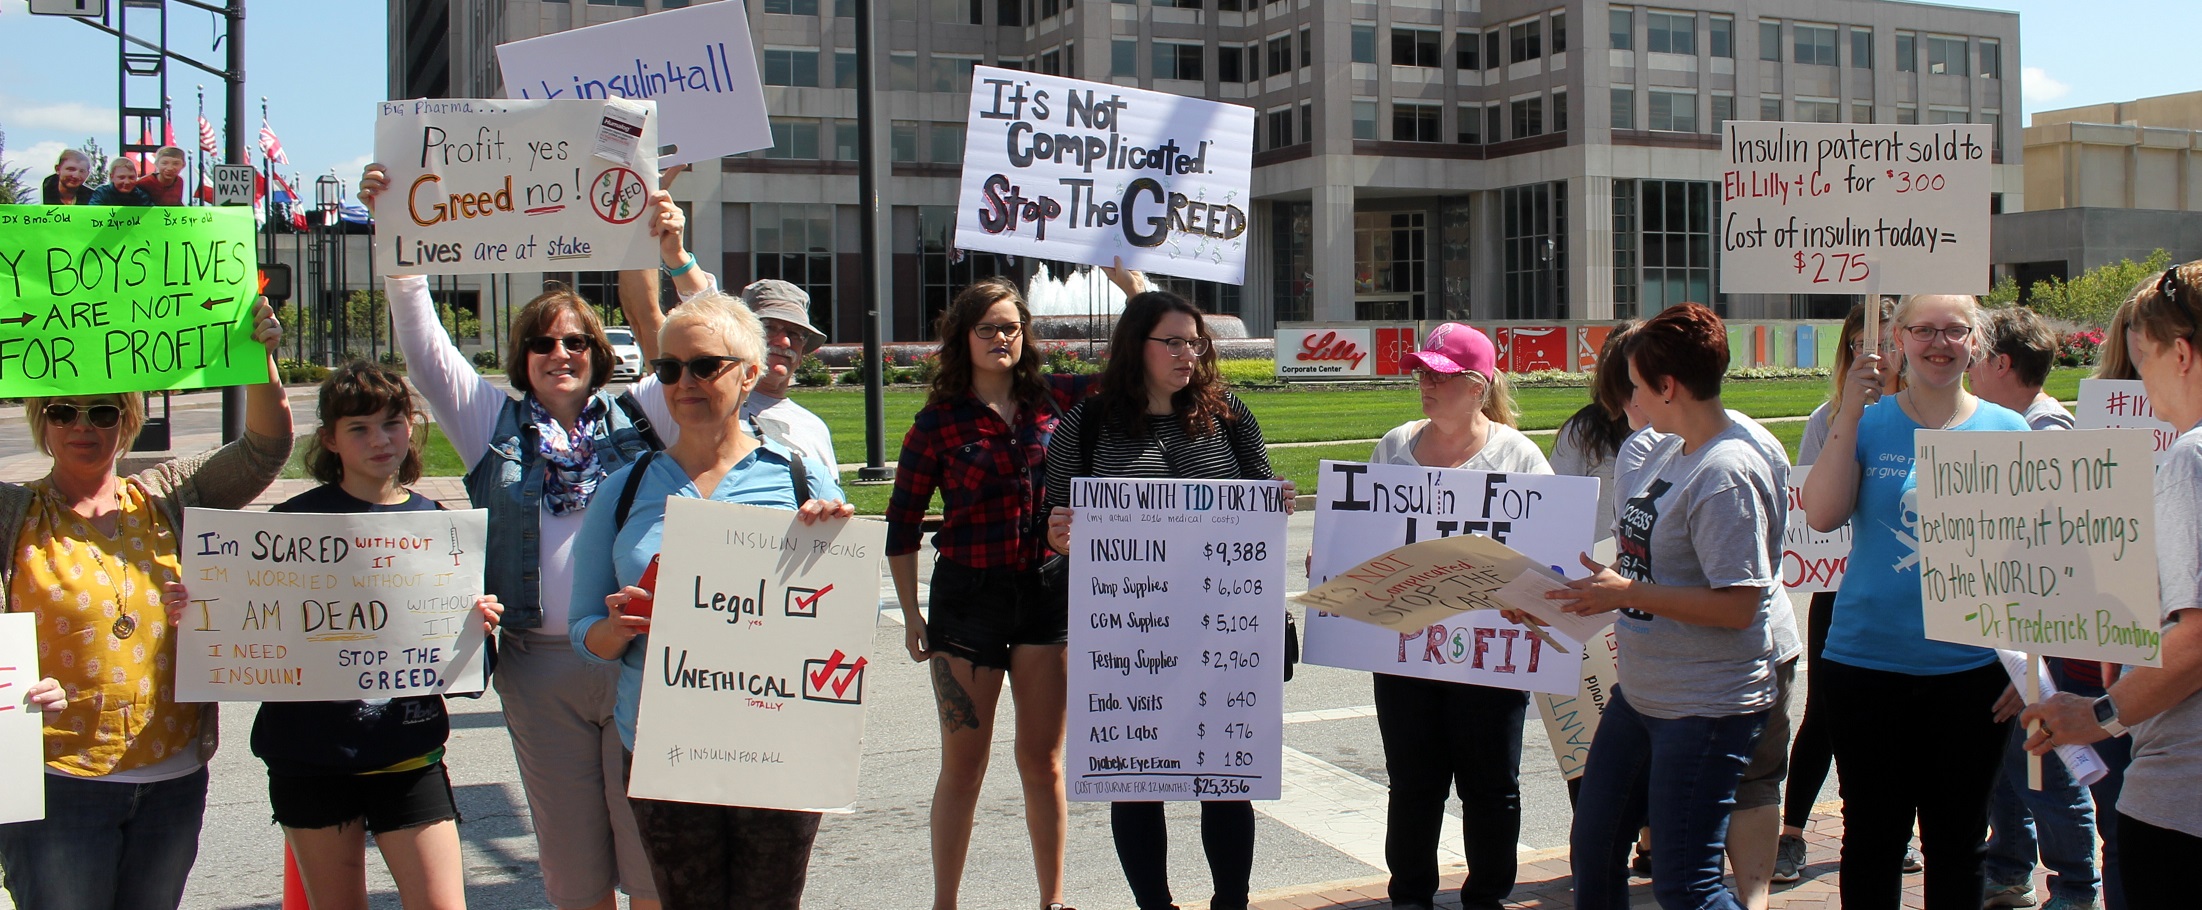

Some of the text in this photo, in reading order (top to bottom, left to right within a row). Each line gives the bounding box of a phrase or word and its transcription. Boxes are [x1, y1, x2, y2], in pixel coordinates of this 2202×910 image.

[980, 78, 1127, 132] It's Not
[421, 126, 568, 171] Profit, yes
[1731, 126, 1983, 172] Insulin patent sold to
[218, 184, 250, 196] WAY
[219, 169, 249, 182] ONE
[1725, 164, 1945, 205] Eli Lilly Co for $3.00
[408, 174, 515, 226] Greed
[979, 174, 1247, 247] Stop The GREED
[127, 216, 140, 225] old
[202, 213, 212, 223] old
[1725, 212, 1767, 251] Cost
[1775, 216, 1798, 248] of
[1804, 217, 1870, 248] insulin
[165, 240, 245, 286] LIVES
[396, 235, 591, 266] Lives are at stake
[1794, 251, 1869, 283] $275
[43, 293, 193, 331] ARE NOT
[0, 320, 237, 379] FOR PROFIT
[1296, 332, 1366, 370] Lilly
[1282, 366, 1317, 374] Corporate
[2009, 441, 2061, 496] does
[2073, 449, 2117, 493] not
[1073, 481, 1287, 513] LIVING WITH T1D FOR 1 YEA
[1331, 464, 1542, 520] Insulin For
[1109, 514, 1131, 522] actual
[1141, 514, 1161, 522] 2016
[1168, 514, 1202, 523] medical
[1212, 514, 1239, 525] costs)
[1625, 525, 1632, 538] TO
[1921, 513, 1975, 557] belong
[1978, 510, 1995, 540] to
[2033, 509, 2051, 546] it
[2059, 507, 2139, 561] belongs
[197, 530, 433, 564] I'm SCARED WITHOUT
[726, 529, 865, 558] INSULIN PRICING
[1091, 539, 1165, 562] INSULIN
[372, 556, 395, 569] IT
[1346, 554, 1414, 585] NOT
[247, 571, 337, 590] WORRIED
[353, 573, 424, 588] WITHOUT
[433, 573, 454, 587] IT
[1092, 577, 1117, 597] Pump
[1123, 576, 1168, 599] Supplies
[1923, 557, 1946, 602] to
[1948, 563, 1976, 598] the
[191, 594, 477, 632] I AM DEAD WITHOUT
[694, 576, 766, 623] Legal
[1368, 585, 1435, 625] STOP
[1440, 570, 1511, 588] THE
[748, 619, 763, 630] yes
[1091, 613, 1122, 629] CGM
[1127, 612, 1169, 633] Supplies
[2007, 603, 2088, 644] Frederick
[2097, 610, 2159, 661] Banting
[208, 644, 287, 659] I NEED
[339, 647, 441, 666] STOP THE
[1089, 650, 1130, 675] Testing
[1135, 649, 1178, 674] Supplies
[209, 667, 302, 686] INSULIN!
[359, 669, 444, 690] GREED.
[664, 646, 795, 698] UNETHICAL
[745, 698, 783, 712] TOTALLY
[1089, 692, 1256, 712] Endo. Visits 640
[1090, 723, 1253, 742] A1C Labs 476
[1089, 756, 1128, 771] Diabetic
[1225, 751, 1253, 766] 180
[1075, 781, 1092, 794] COST
[1094, 781, 1105, 793] TO
[1105, 781, 1132, 793] SURVIVE
[1134, 781, 1147, 793] FOR
[1149, 781, 1158, 793] 12
[1193, 777, 1249, 797] $25,356
